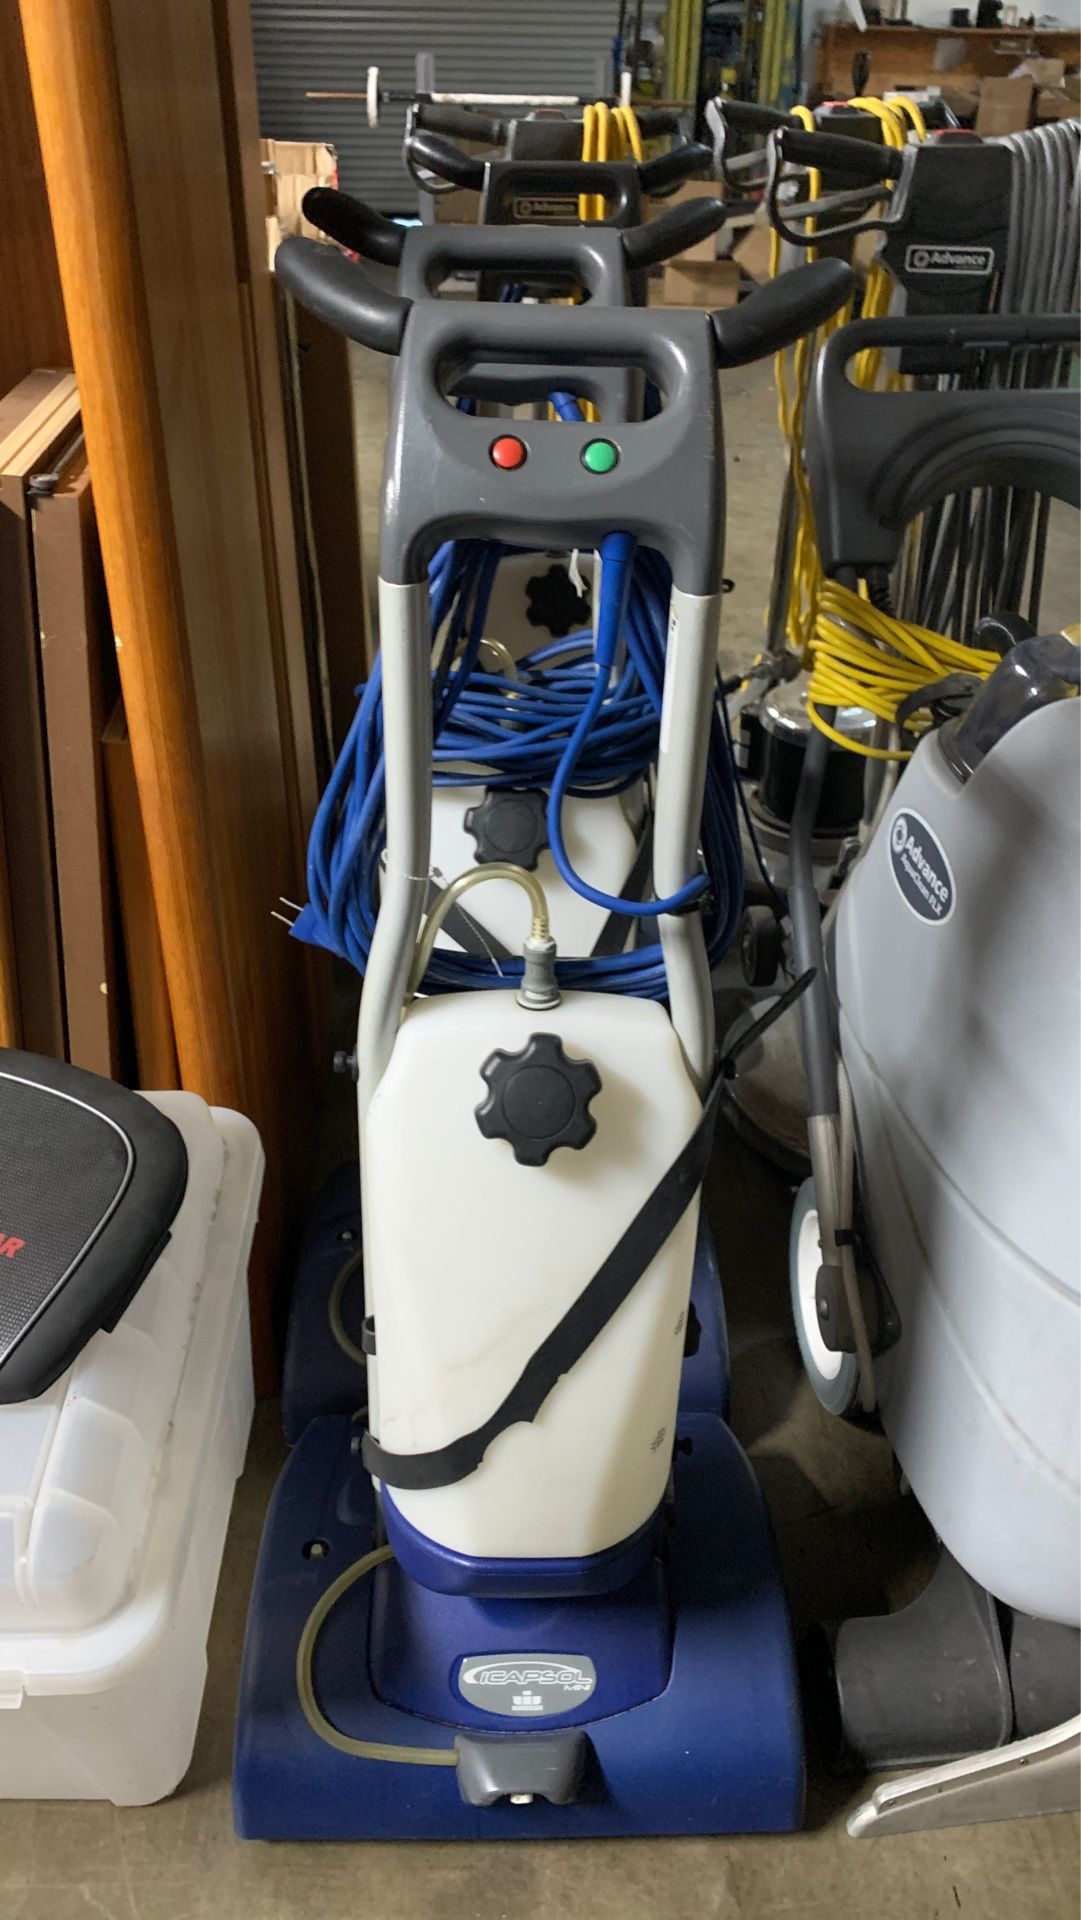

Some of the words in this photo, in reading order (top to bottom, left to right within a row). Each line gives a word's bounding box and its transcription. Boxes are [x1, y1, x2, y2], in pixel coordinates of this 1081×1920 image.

[929, 252, 986, 265] Advance
[905, 835, 949, 902] Advance
[928, 895, 943, 917] FLX
